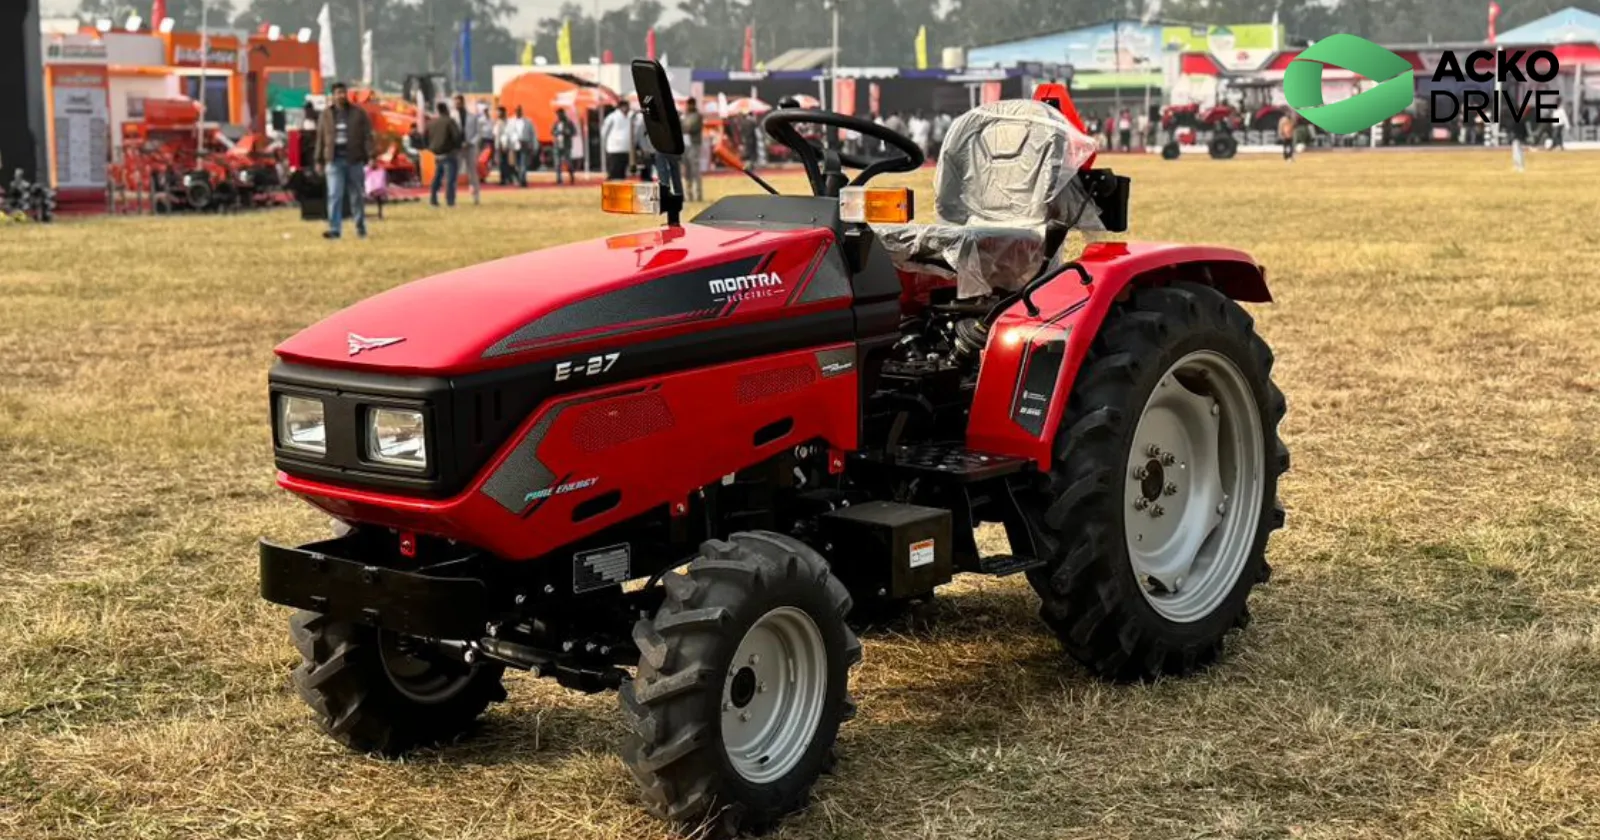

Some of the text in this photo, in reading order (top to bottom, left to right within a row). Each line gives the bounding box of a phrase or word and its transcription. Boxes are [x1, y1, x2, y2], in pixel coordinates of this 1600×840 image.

[708, 271, 783, 295] MONTRA
[554, 351, 621, 382] E-27
[524, 475, 600, 502] PURE ENERGY
